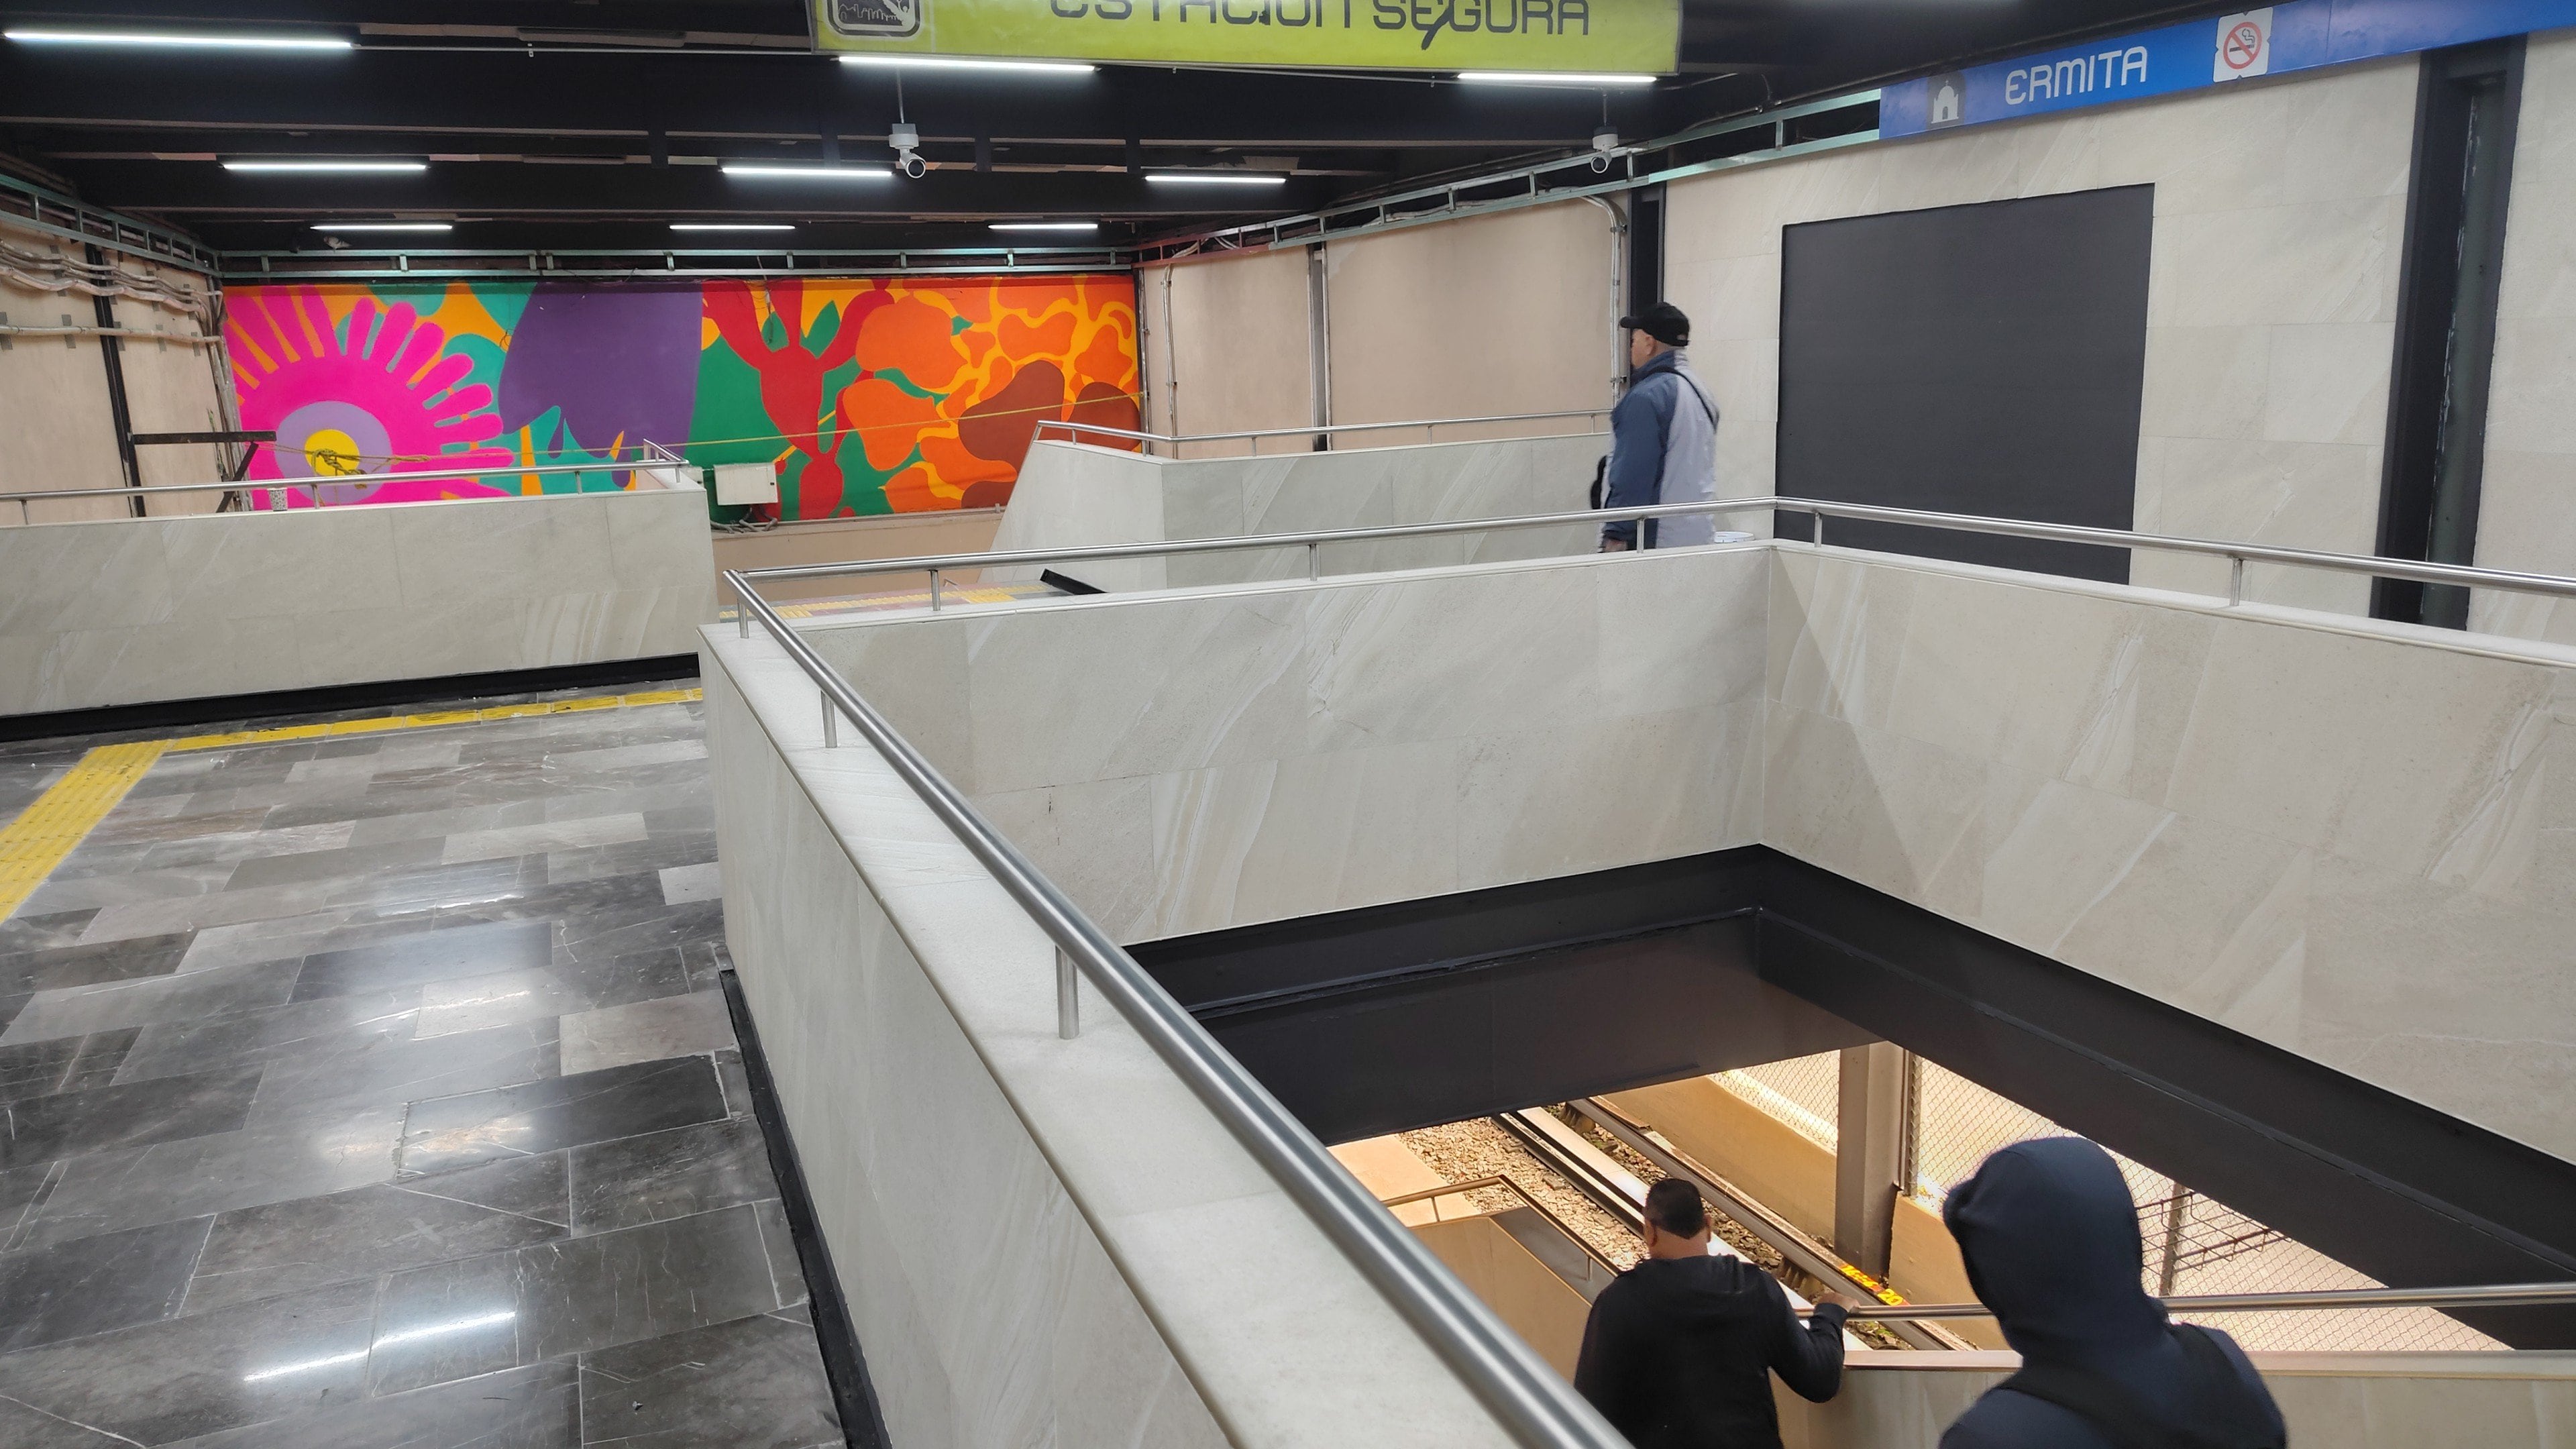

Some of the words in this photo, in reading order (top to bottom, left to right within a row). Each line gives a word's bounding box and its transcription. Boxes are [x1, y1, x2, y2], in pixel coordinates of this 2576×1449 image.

[1373, 0, 1589, 36] SEGURA
[2005, 46, 2148, 105] ERMITA
[1877, 1288, 1904, 1306] 20
